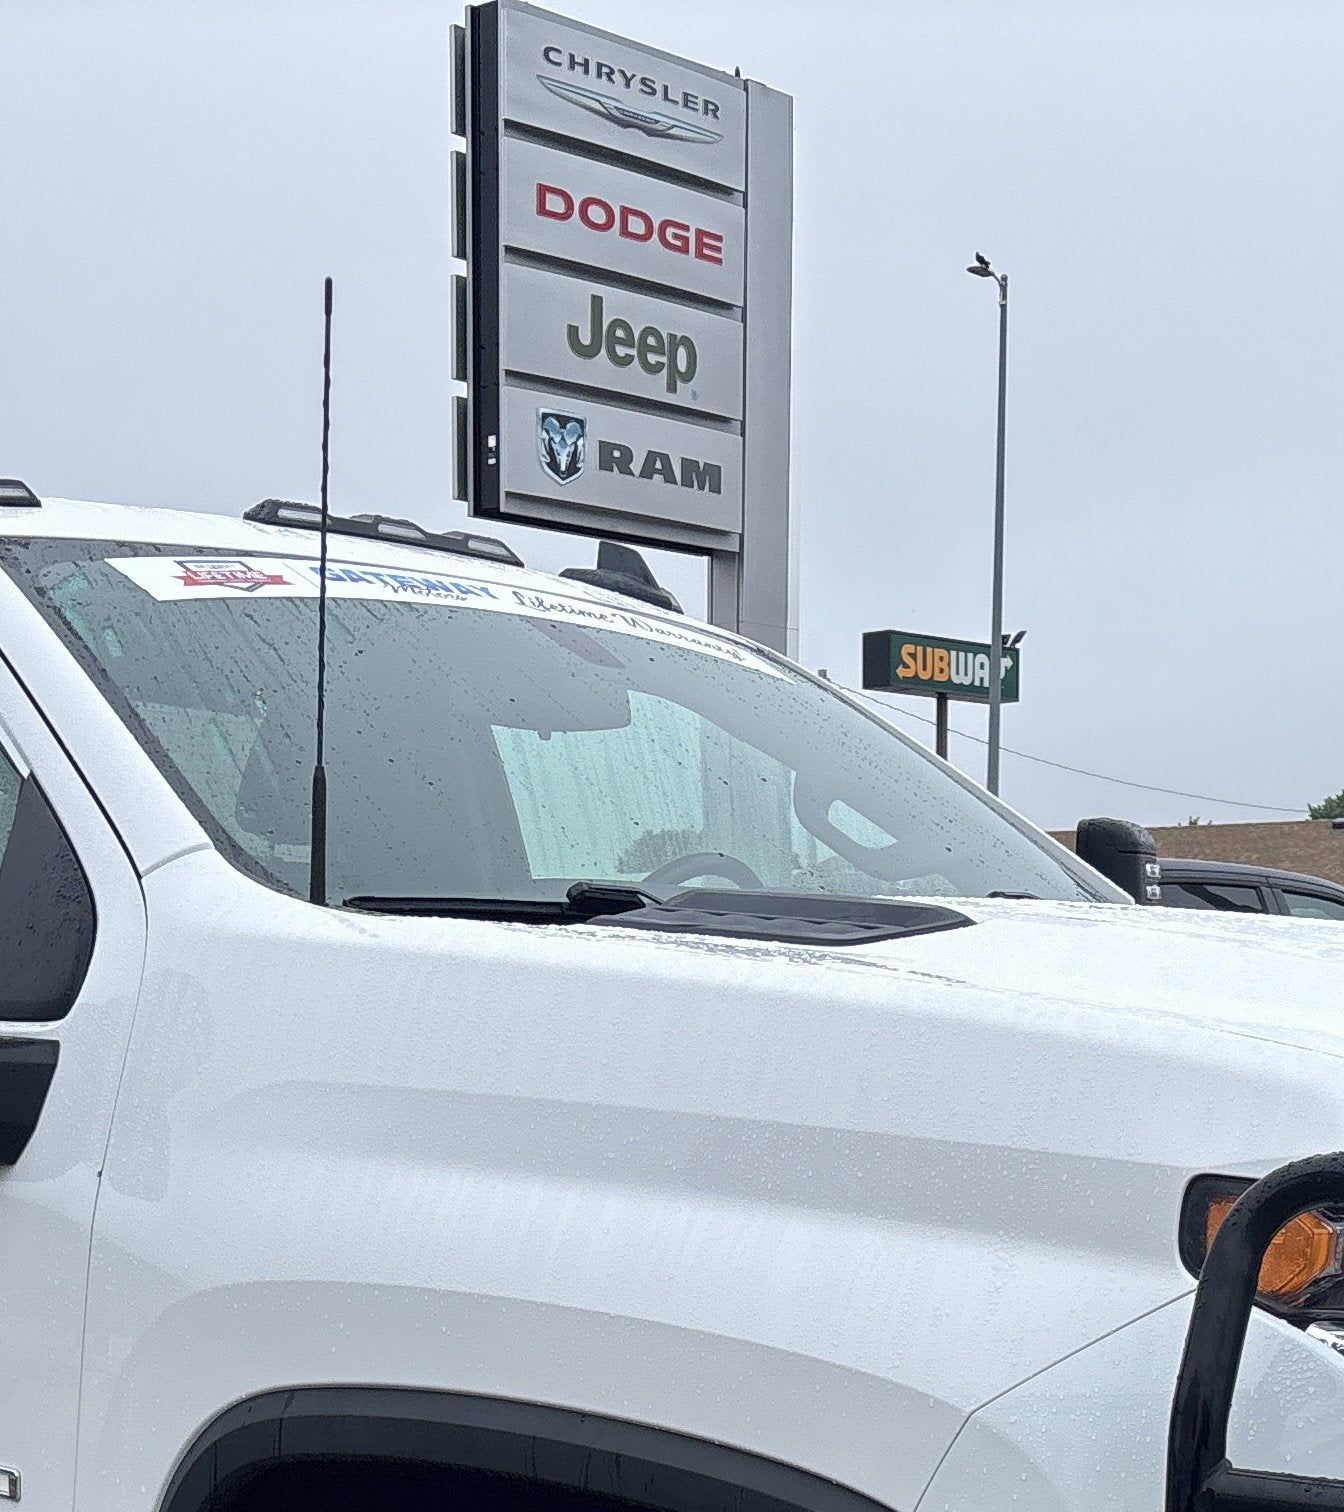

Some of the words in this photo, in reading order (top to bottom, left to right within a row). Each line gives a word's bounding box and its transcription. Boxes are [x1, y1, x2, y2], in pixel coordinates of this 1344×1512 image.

[542, 45, 722, 121] CHRYSLER
[535, 182, 724, 266] DODGE
[566, 294, 698, 393] Jeep
[597, 440, 723, 494] RAM
[308, 566, 500, 599] GATEWAY
[511, 590, 615, 624] Lifetime
